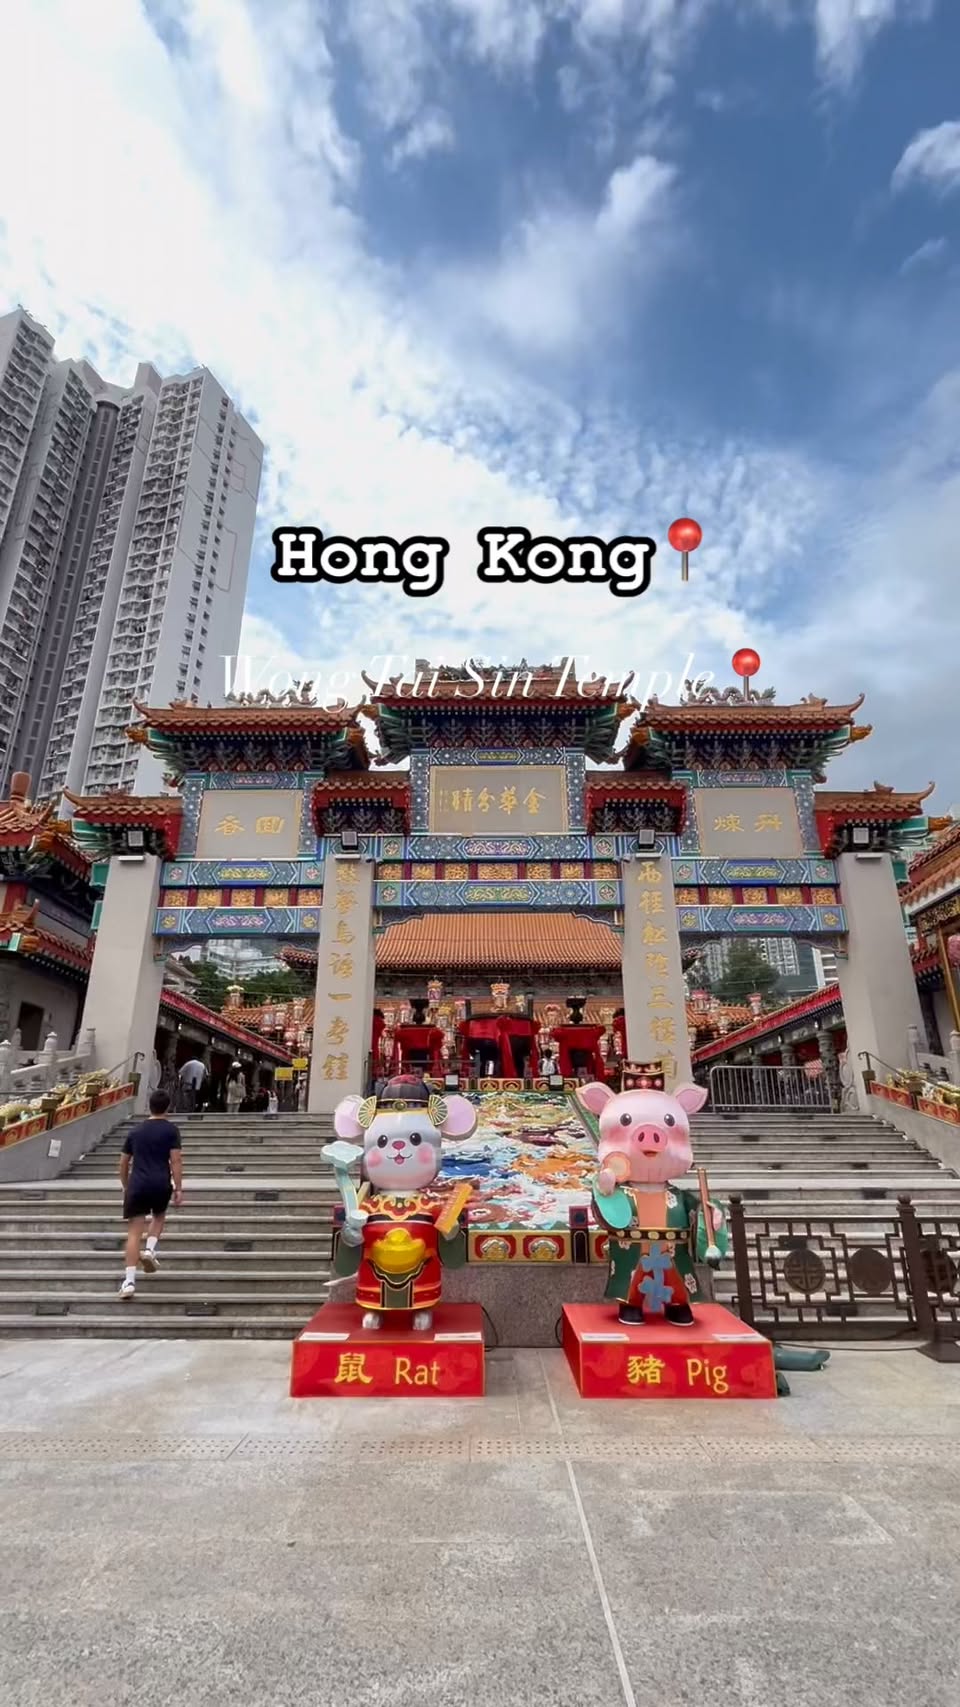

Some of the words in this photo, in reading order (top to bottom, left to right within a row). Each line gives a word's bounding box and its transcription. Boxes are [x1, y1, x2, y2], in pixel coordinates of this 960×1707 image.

[334, 1352, 374, 1385] 鼠
[395, 1357, 441, 1386] Rat
[627, 1354, 665, 1384] 豬
[687, 1358, 730, 1394] Pig
